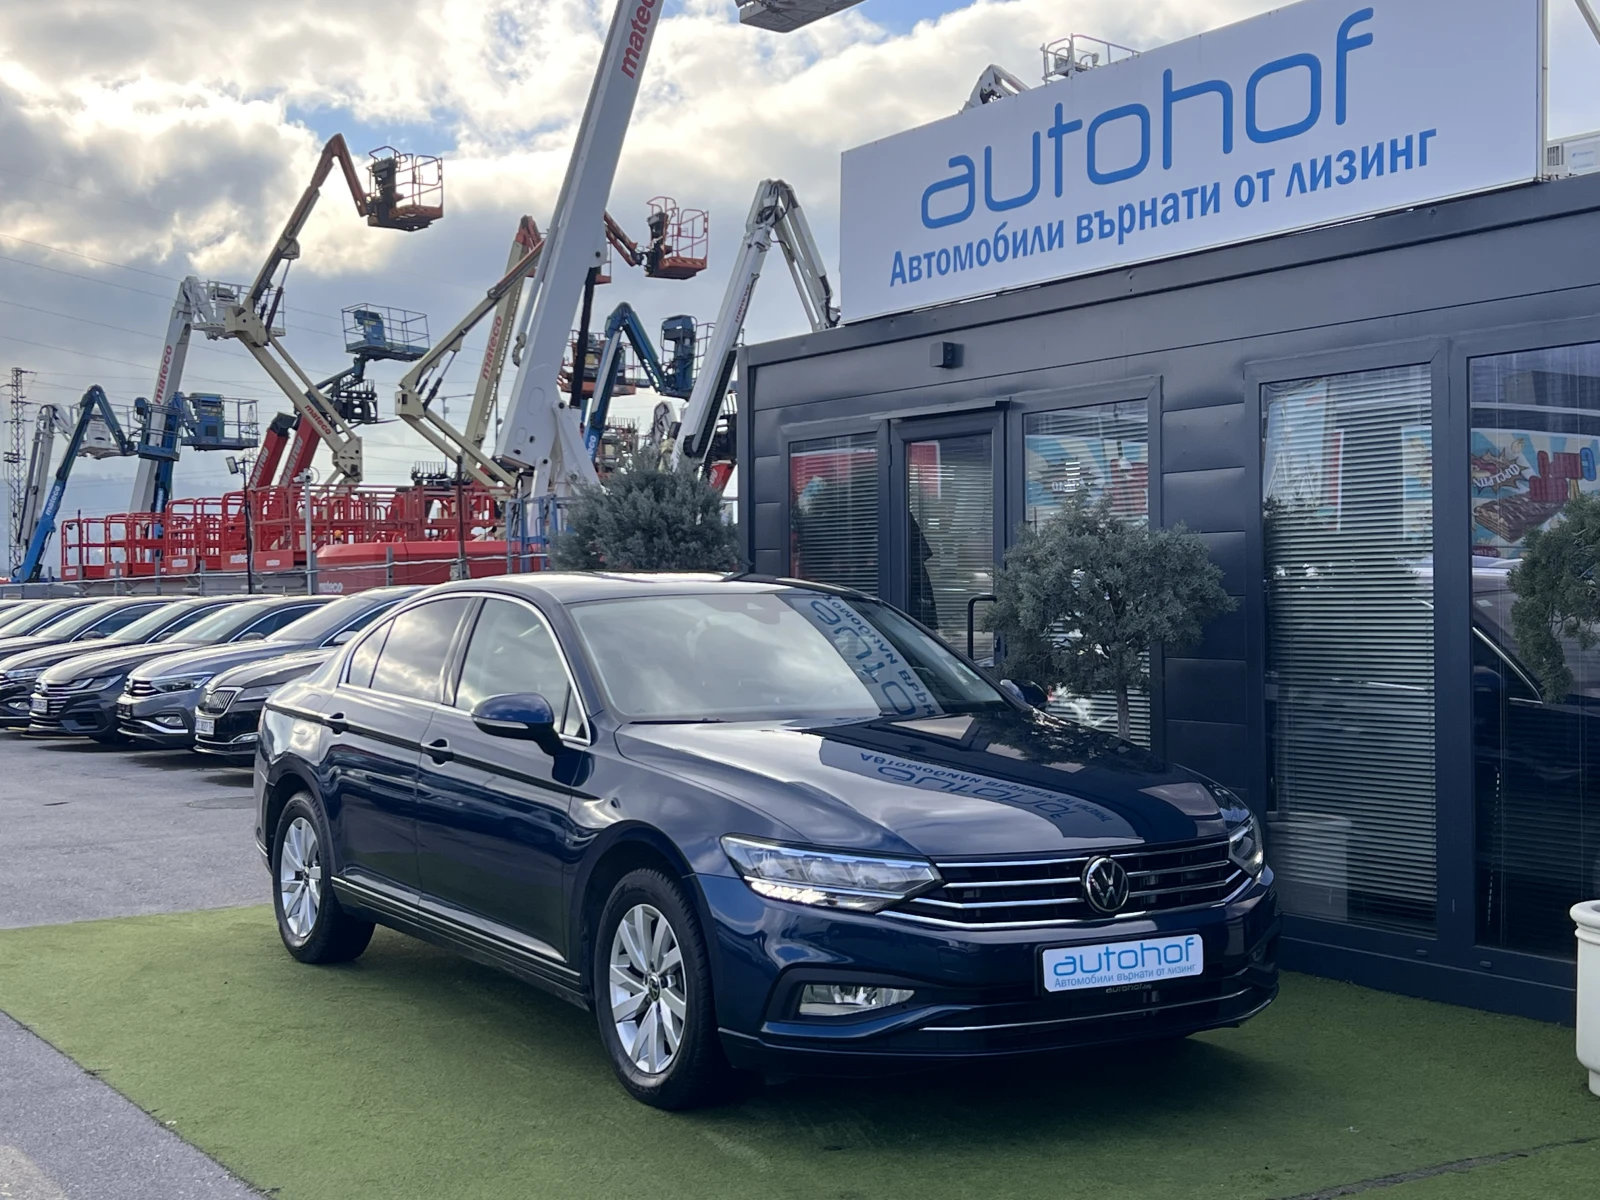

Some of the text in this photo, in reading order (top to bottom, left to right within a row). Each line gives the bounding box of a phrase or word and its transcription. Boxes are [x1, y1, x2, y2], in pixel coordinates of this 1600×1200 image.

[921, 7, 1374, 229] autohof
[890, 128, 1437, 287] Автомобили върнати от лизинг
[482, 315, 502, 380] mateco
[154, 344, 173, 405] mateco
[304, 404, 332, 435] mateco
[45, 485, 61, 516] mateco
[1053, 936, 1195, 977] autohof
[1054, 964, 1196, 988] Автомобили върнати от лизинг
